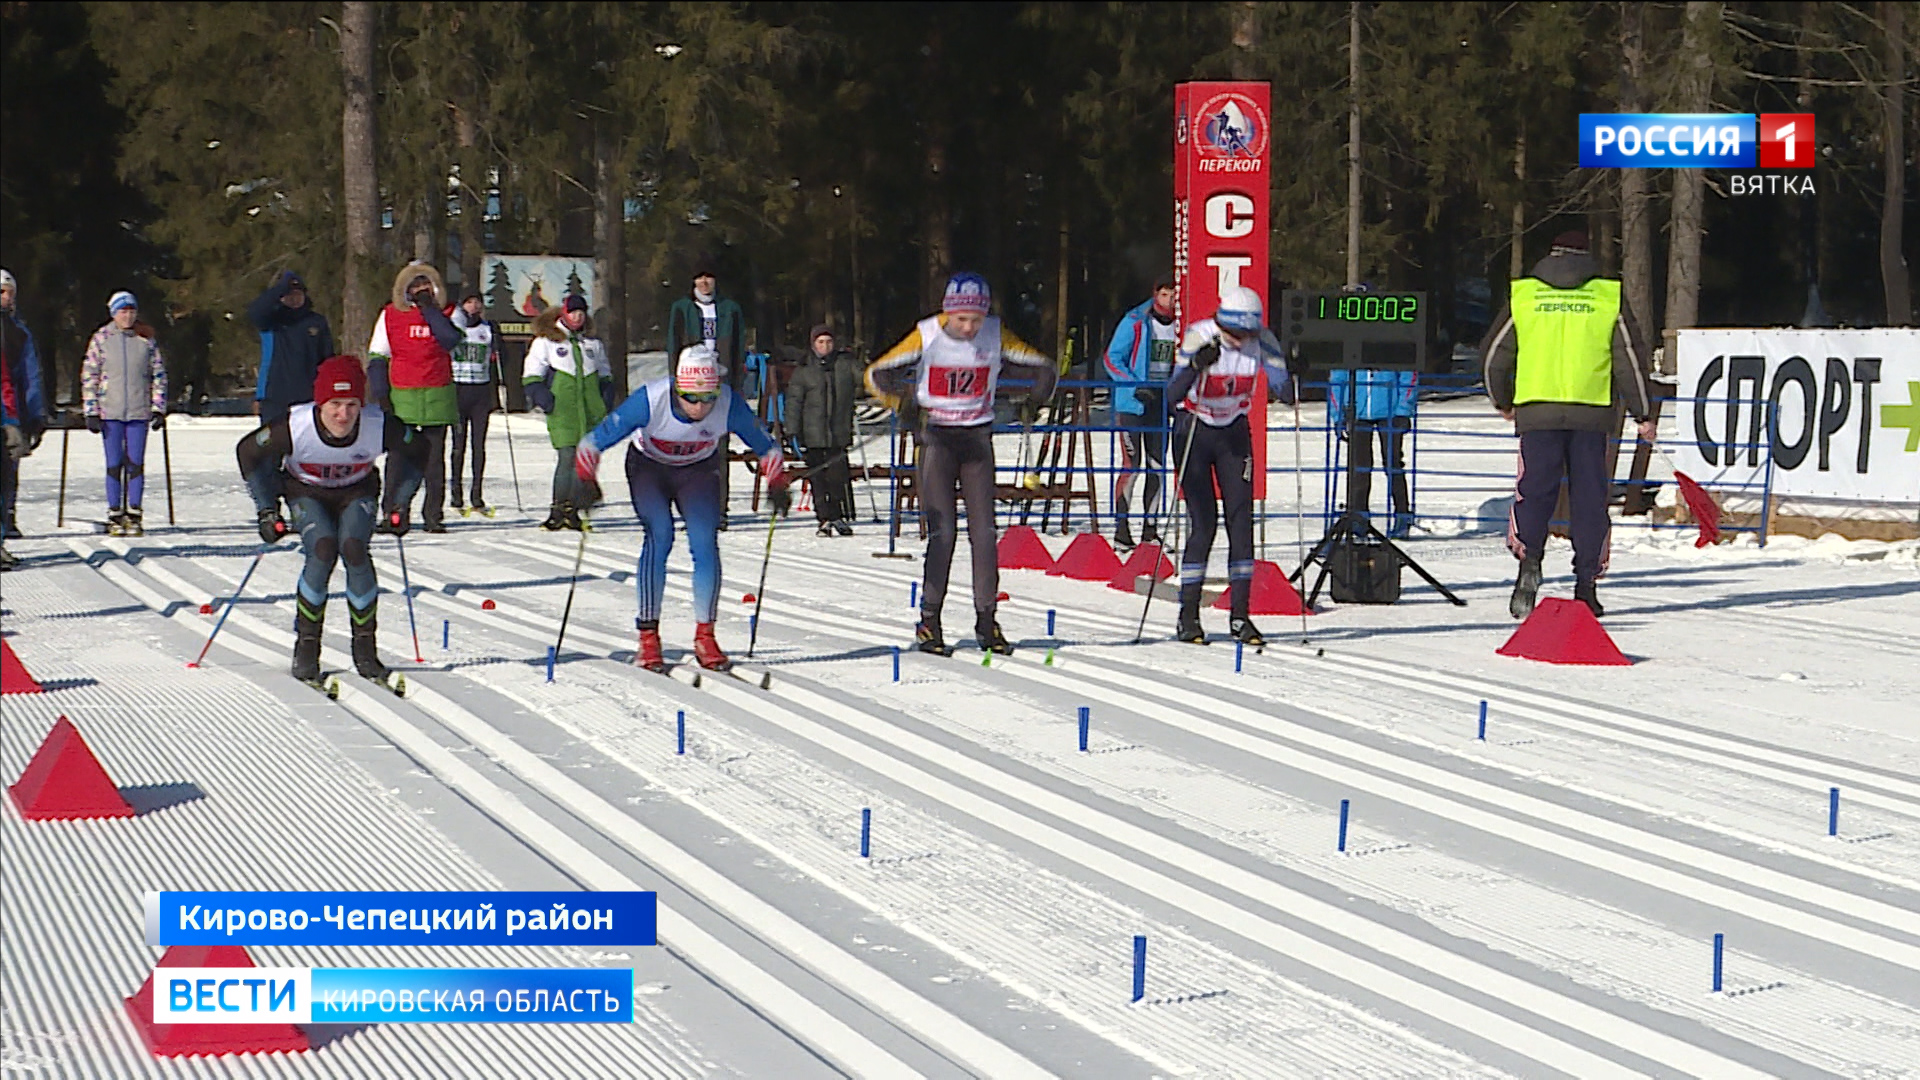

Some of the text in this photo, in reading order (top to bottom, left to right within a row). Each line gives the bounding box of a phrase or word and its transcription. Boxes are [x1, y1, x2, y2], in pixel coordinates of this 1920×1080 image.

[1199, 159, 1262, 172] ПЕРЕКОП
[1320, 297, 1417, 321] 11:00:02
[947, 368, 976, 396] 12
[1694, 355, 1882, 474] СПОРТ
